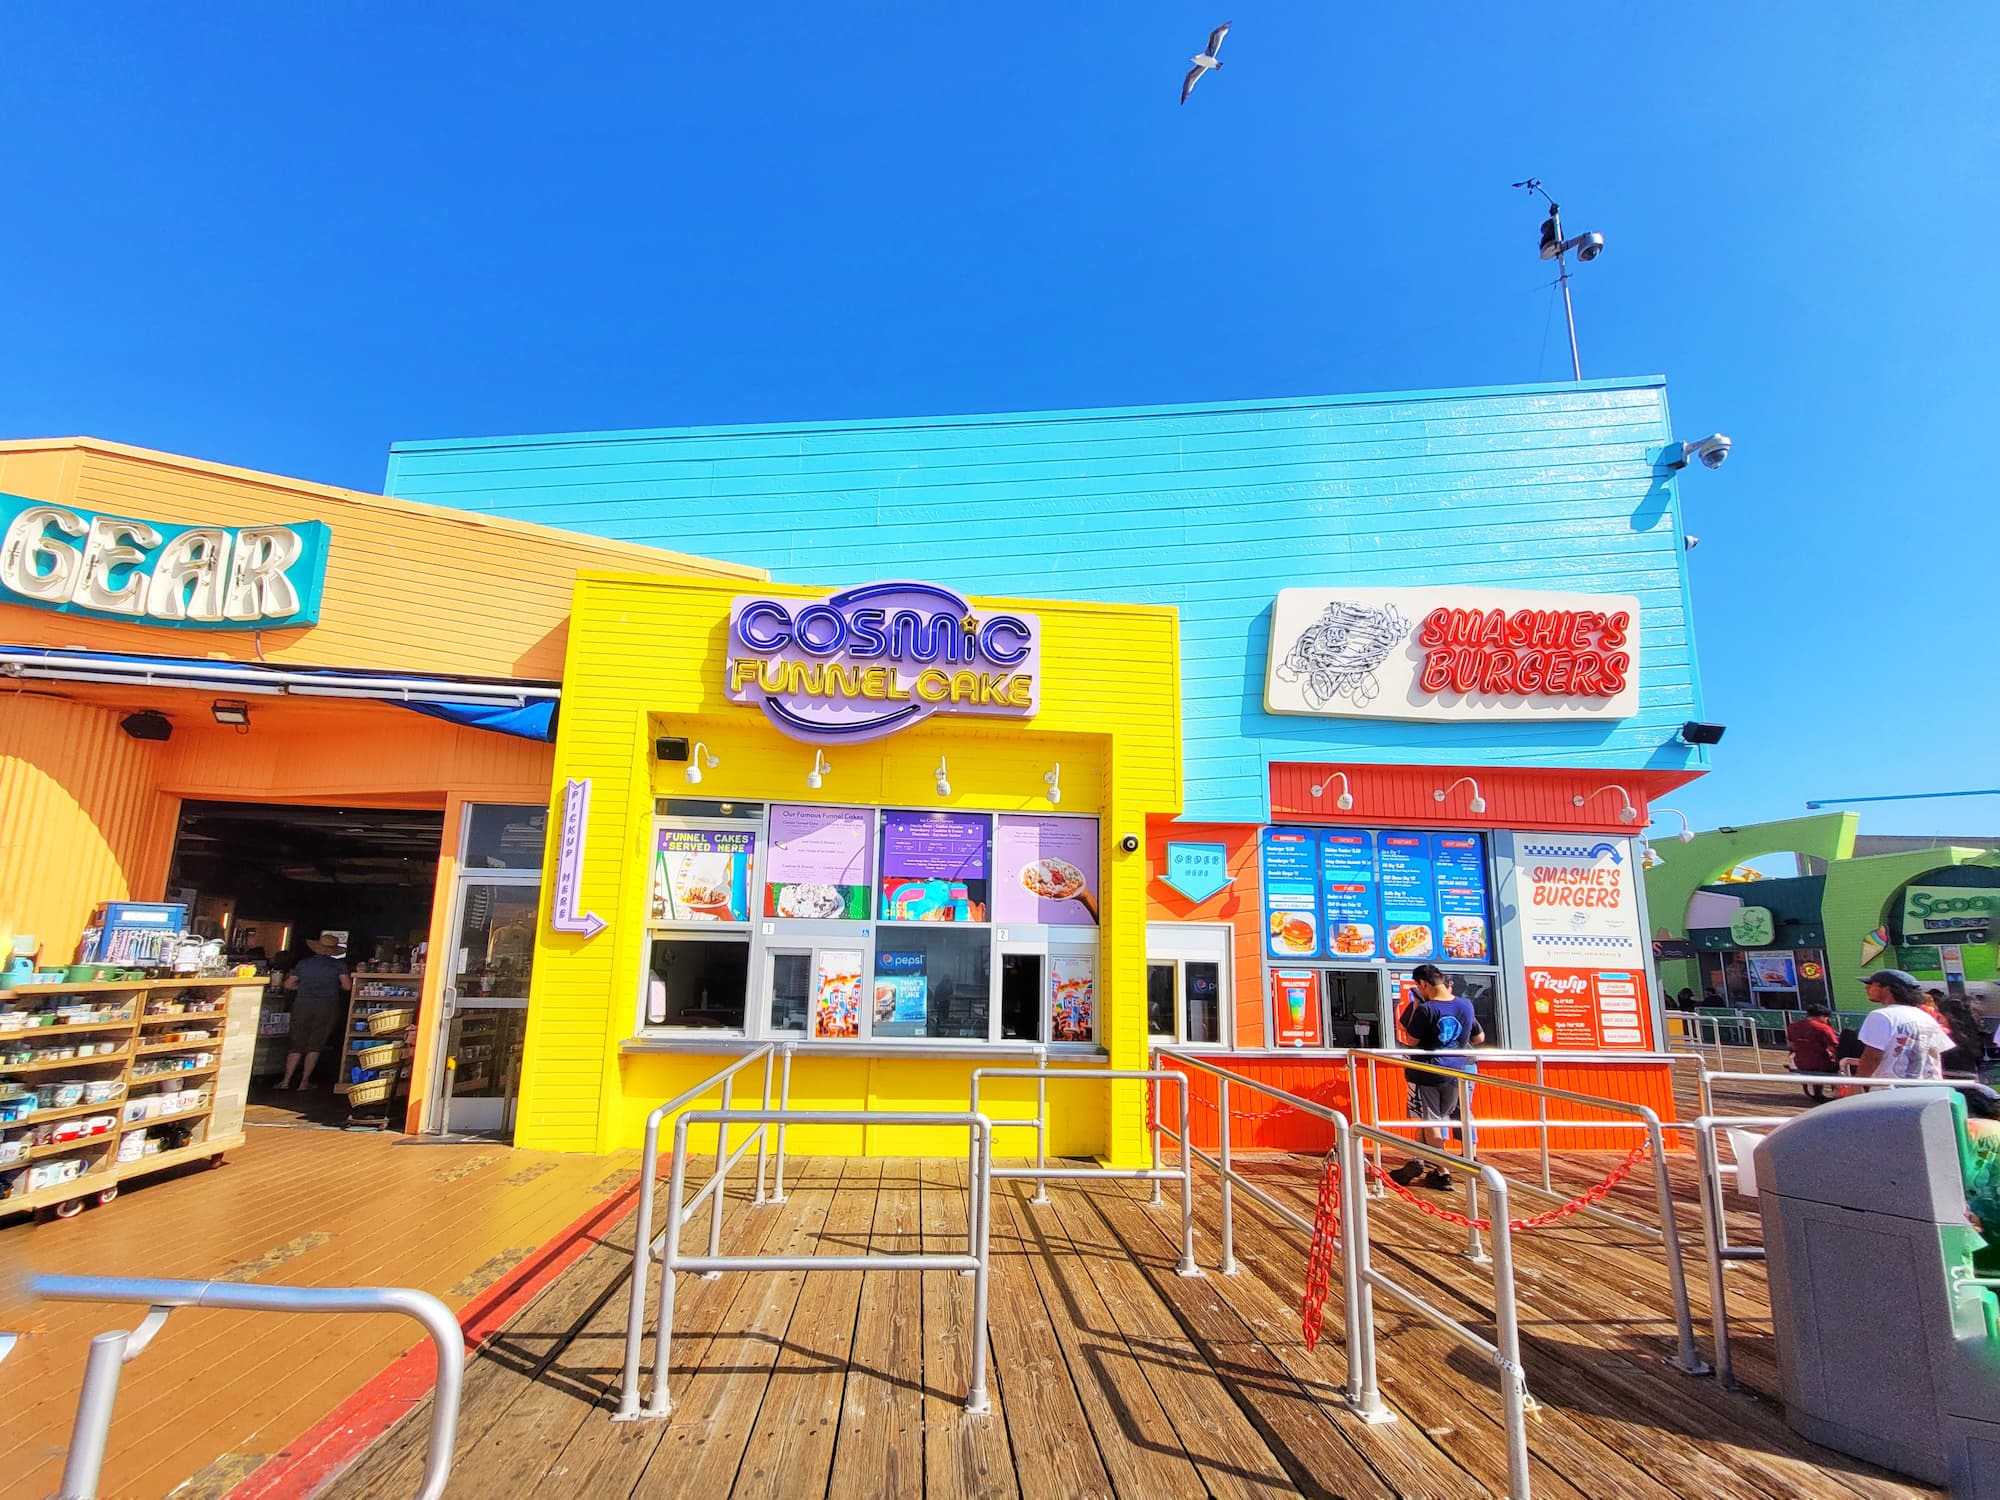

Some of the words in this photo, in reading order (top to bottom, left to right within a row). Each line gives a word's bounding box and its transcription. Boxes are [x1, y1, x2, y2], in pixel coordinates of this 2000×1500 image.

[0, 506, 303, 622] GEAR
[1421, 607, 1631, 650] SMASHIE'S
[730, 658, 911, 702] FUNNEL
[916, 667, 1033, 708] CAKE
[1421, 649, 1631, 698] BURGERS
[665, 832, 708, 842] FUNNEL
[714, 834, 749, 843] CAKES
[669, 842, 711, 852] SERVED
[717, 844, 745, 852] HERE
[1174, 854, 1220, 866] ORDER
[1532, 866, 1621, 887] SMASHIE'S
[558, 873, 571, 919] HERE
[1532, 886, 1621, 908] BURGERS
[1950, 918, 1991, 928] CREA
[895, 954, 924, 966] pepsi
